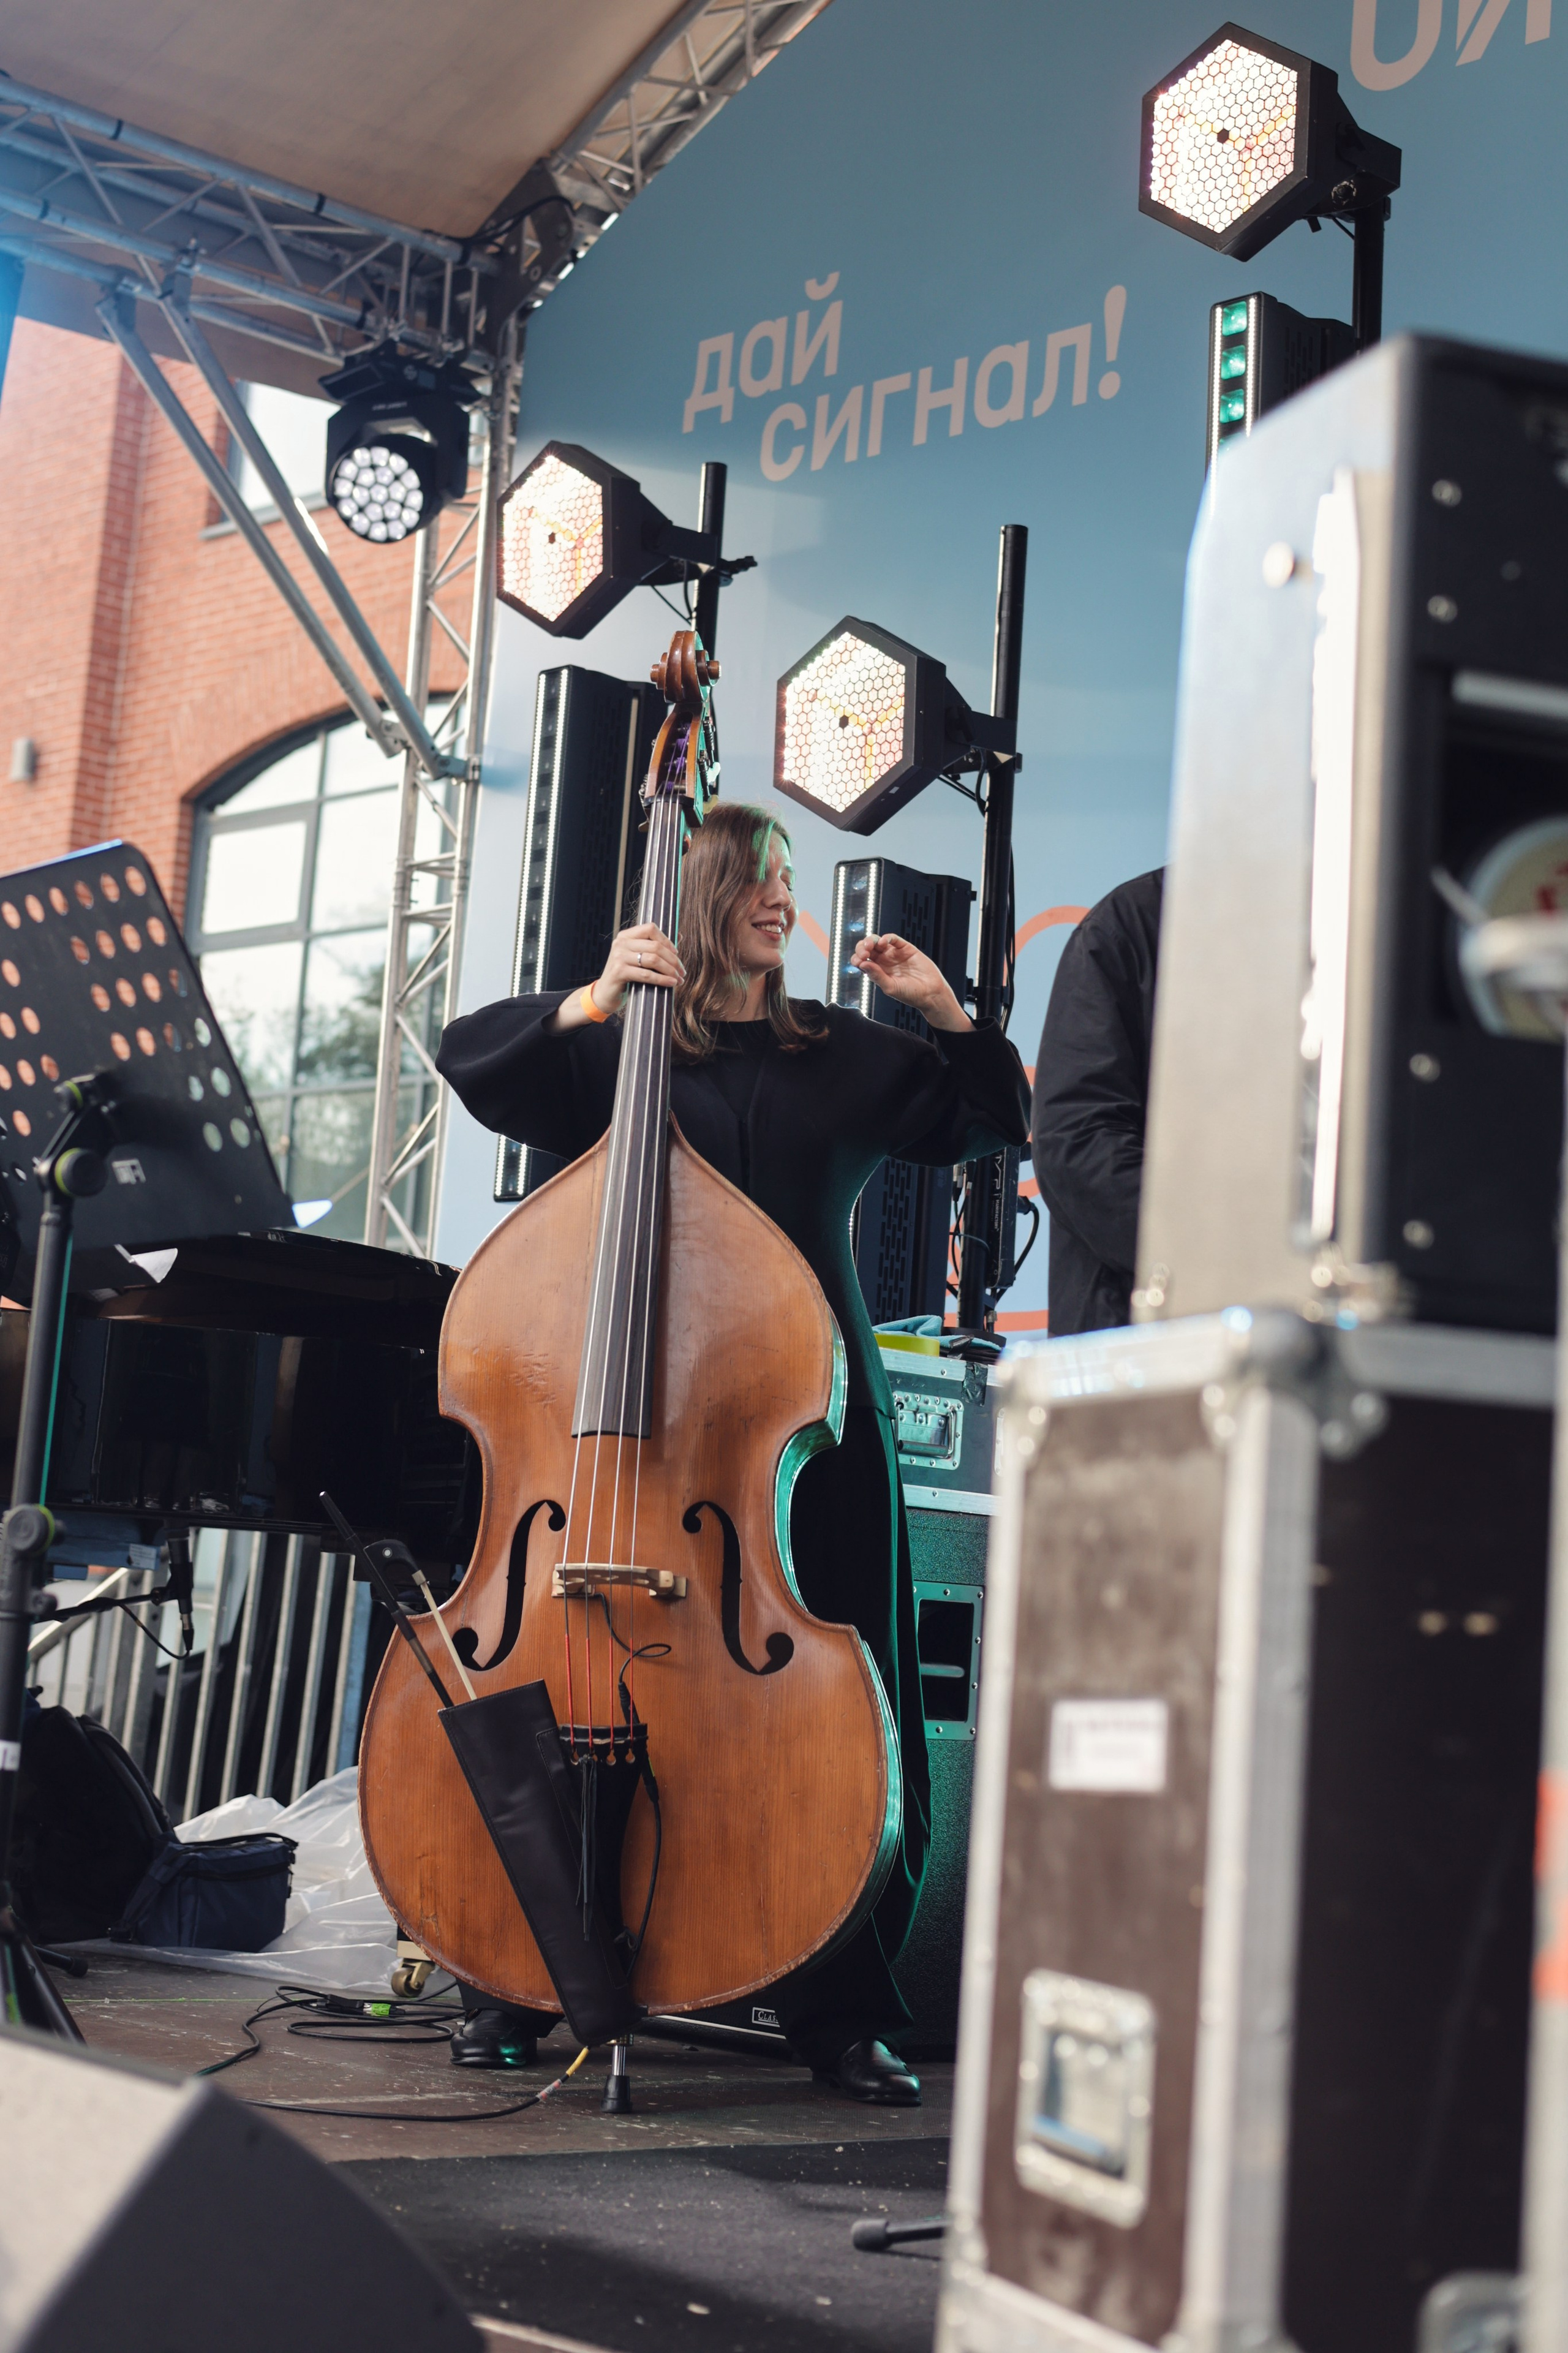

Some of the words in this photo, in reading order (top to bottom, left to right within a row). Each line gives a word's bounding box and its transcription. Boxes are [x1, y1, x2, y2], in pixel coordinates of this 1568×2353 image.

[682, 271, 843, 434] дай
[760, 284, 1127, 482] сигнал!
[758, 2011, 778, 2022] CLAS
